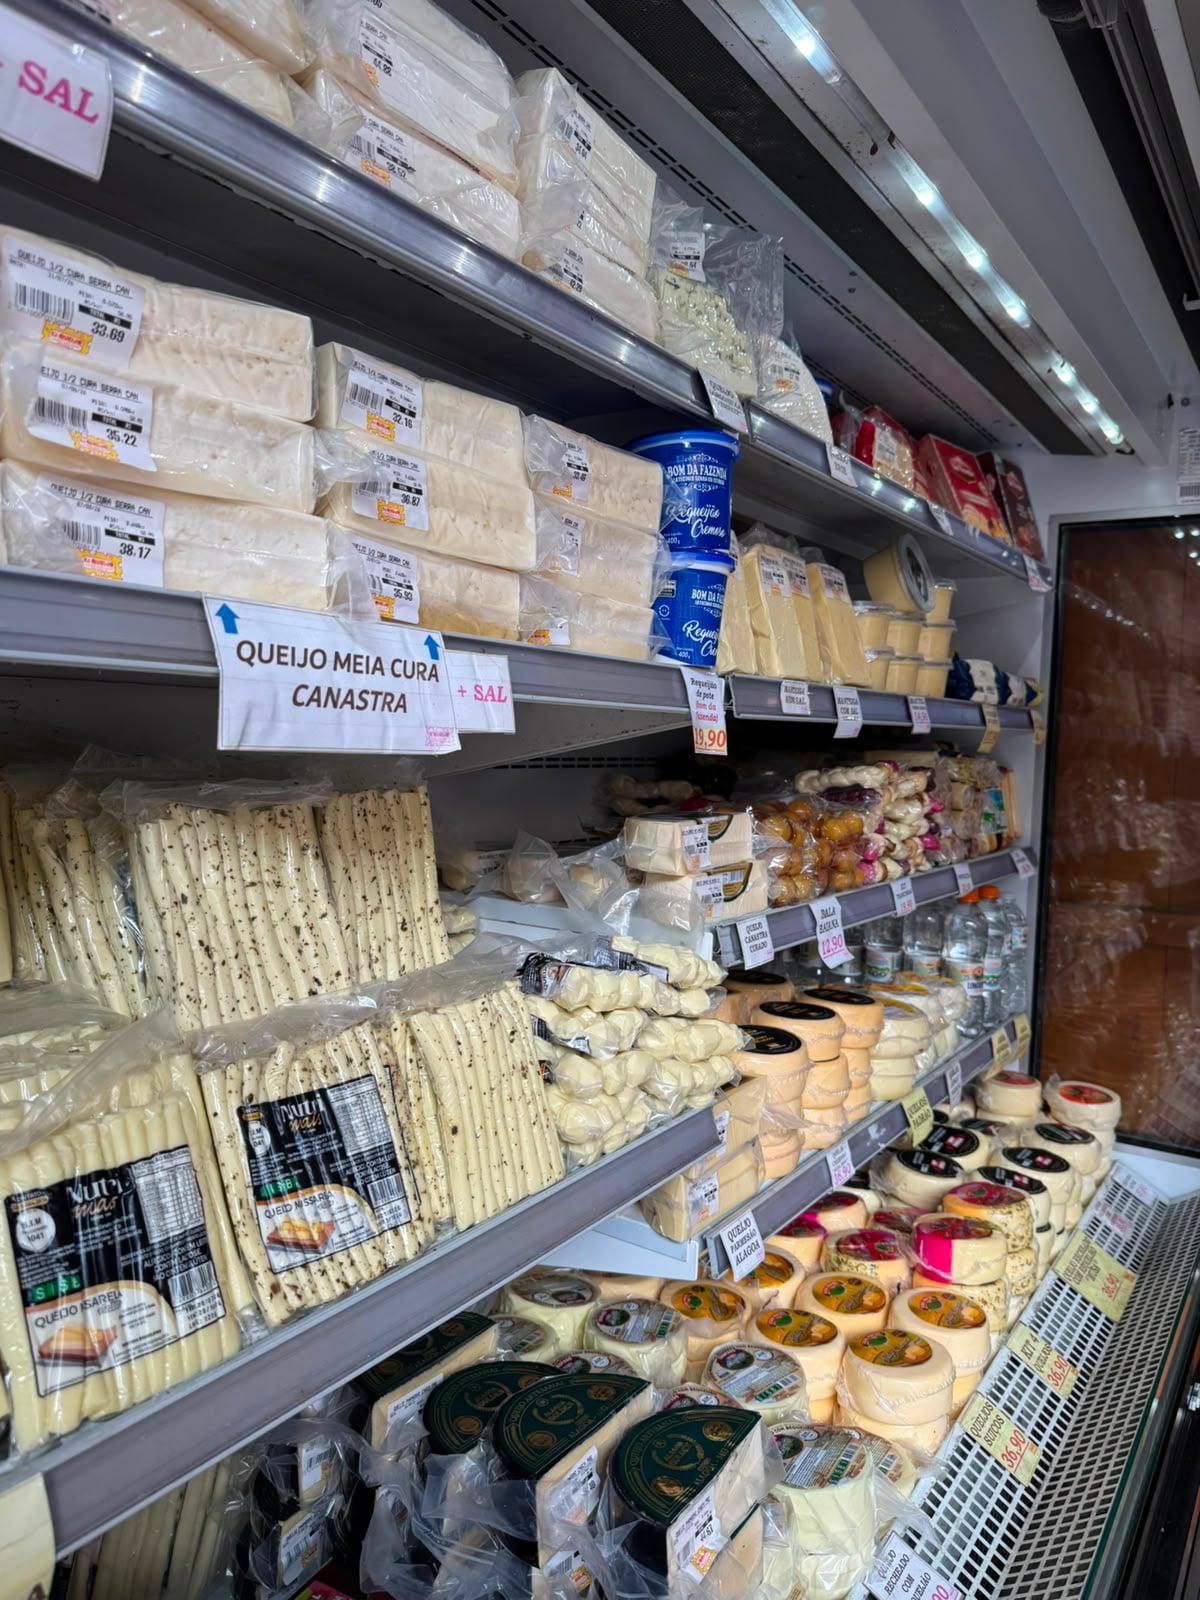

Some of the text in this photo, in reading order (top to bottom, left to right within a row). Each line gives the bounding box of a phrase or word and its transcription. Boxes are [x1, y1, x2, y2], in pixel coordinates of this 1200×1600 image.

[18, 60, 99, 124] SAL
[18, 249, 46, 266] QUEIJO
[667, 464, 727, 480] BOM DA FAZENDA
[692, 589, 707, 600] BOM
[236, 639, 440, 683] QUEIJO MEIA CURA
[292, 684, 408, 714] CANASTRA
[457, 683, 507, 704] + SAL
[694, 727, 727, 749] 19,90
[727, 1217, 751, 1243] QUEIJO
[730, 1228, 757, 1254] PARMESÃO
[736, 1239, 760, 1267] ALAGOA
[1021, 1333, 1040, 1361] KIT 4
[1034, 1343, 1053, 1373] QUEIJOS
[1047, 1354, 1069, 1388] 36,90
[969, 1400, 994, 1439] QUEIJOS
[1001, 1428, 1027, 1469] 36,90
[883, 1553, 910, 1596] RECHEADO
[901, 1573, 915, 1593] COM
